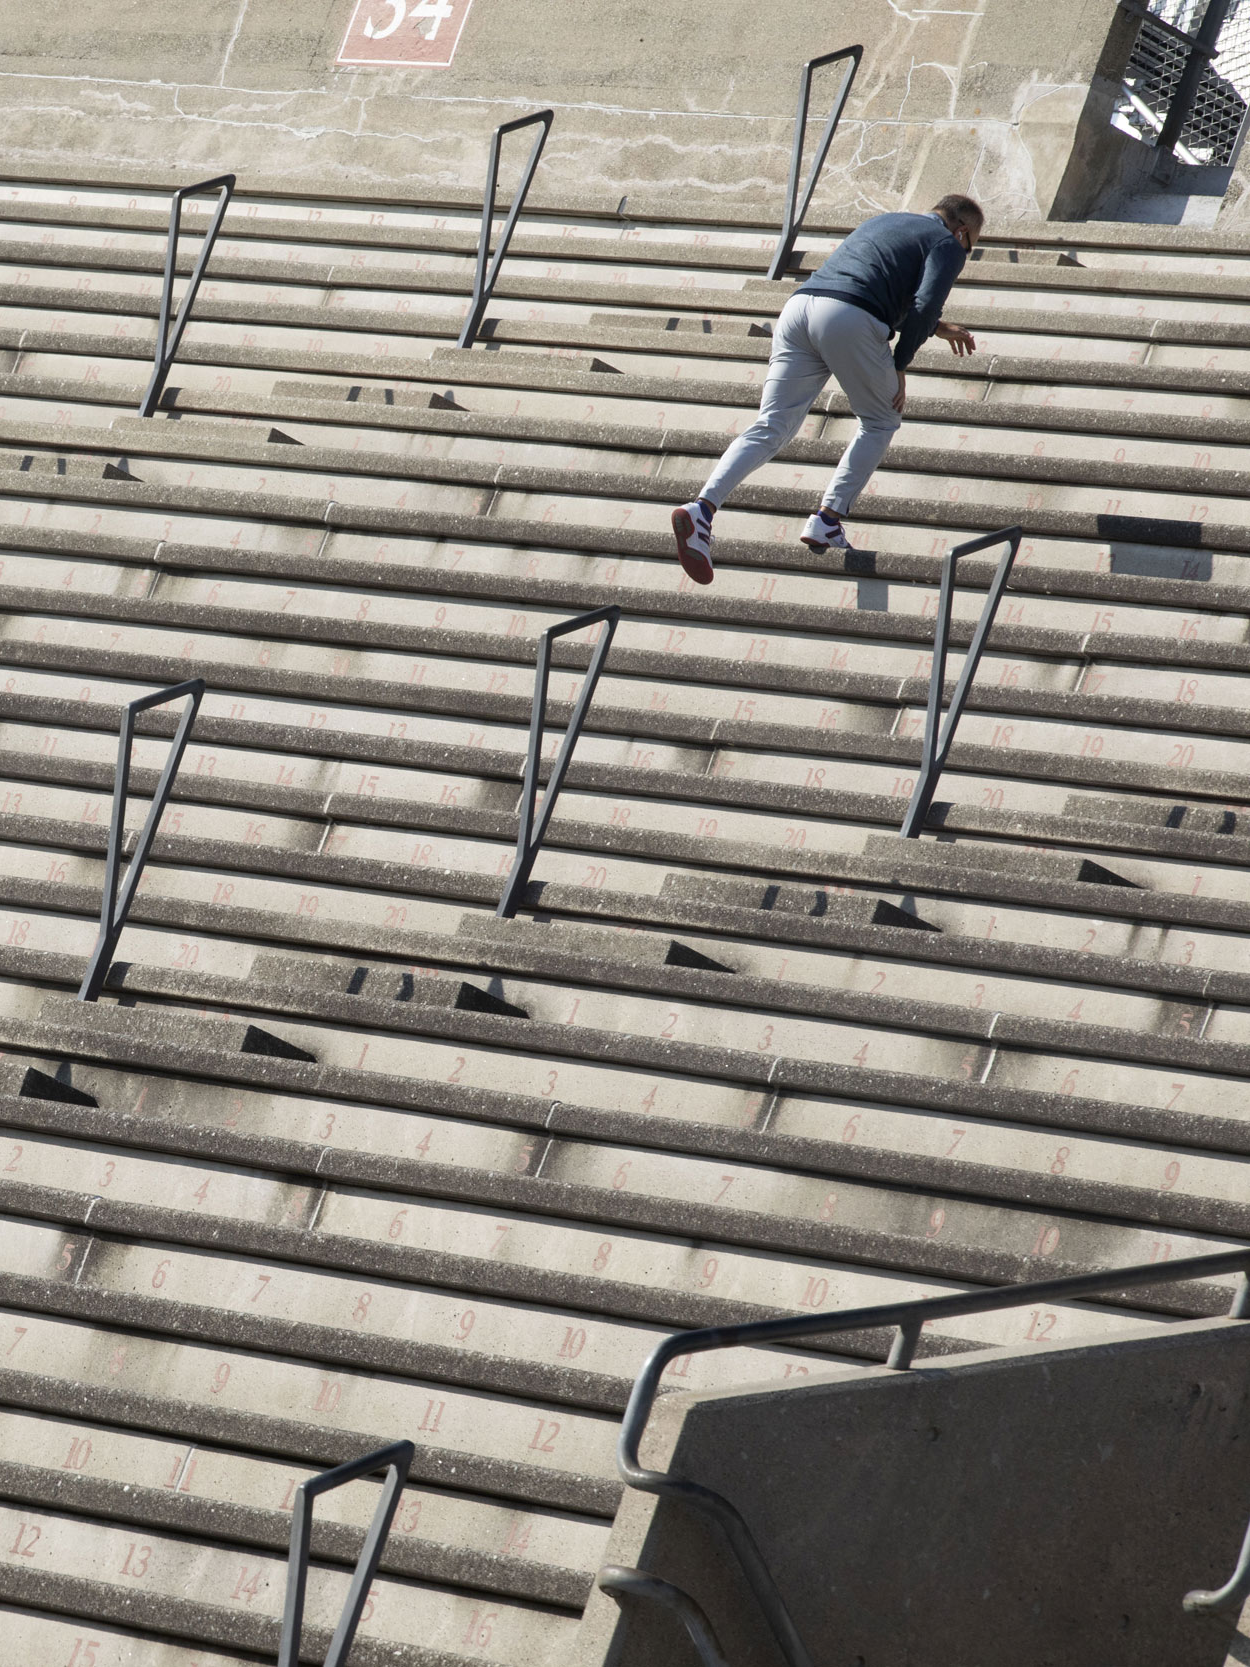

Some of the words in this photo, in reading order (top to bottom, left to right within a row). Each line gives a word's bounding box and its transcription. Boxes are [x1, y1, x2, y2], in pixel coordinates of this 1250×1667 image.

[201, 287, 217, 299] 15
[792, 472, 803, 486] 7
[621, 510, 632, 528] 7
[1104, 499, 1121, 513] 11
[1187, 504, 1209, 521] 12
[283, 590, 297, 609] 7
[757, 578, 777, 601] 11
[839, 587, 856, 609] 12
[505, 615, 527, 638] 10
[1091, 611, 1114, 633] 15
[663, 629, 686, 653] 12
[745, 638, 768, 662] 13
[827, 648, 849, 672] 14
[409, 664, 427, 683] 11
[486, 672, 509, 695] 12
[734, 699, 756, 720] 15
[991, 725, 1014, 747] 18
[1166, 744, 1195, 768] 20
[357, 774, 380, 796] 15
[805, 768, 826, 788] 18
[891, 778, 915, 797] 19
[2, 791, 22, 813] 13
[439, 785, 461, 806] 16
[80, 802, 100, 824] 14
[159, 811, 185, 834] 15
[609, 807, 630, 827] 18
[47, 860, 69, 882] 16
[1191, 875, 1203, 896] 1
[296, 893, 319, 917] 19
[6, 920, 31, 945] 18
[985, 915, 997, 939] 1
[869, 971, 887, 995] 2
[566, 998, 581, 1025] 1
[1067, 1000, 1084, 1022] 4
[661, 1012, 678, 1039] 2
[352, 1043, 370, 1070] 1
[853, 1043, 869, 1067] 4
[447, 1056, 466, 1084] 2
[541, 1070, 559, 1097] 3
[1166, 1083, 1185, 1110] 7
[641, 1087, 657, 1113] 4
[318, 1113, 338, 1140] 3
[842, 1114, 862, 1143] 6
[416, 1131, 432, 1155] 4
[946, 1128, 966, 1156] 7
[4, 1145, 23, 1171] 2
[1050, 1146, 1070, 1175] 8
[98, 1161, 116, 1187] 3
[612, 1159, 632, 1191] 6
[1160, 1161, 1181, 1190] 9
[193, 1180, 210, 1205] 4
[714, 1174, 734, 1204] 7
[925, 1208, 945, 1239] 9
[1031, 1226, 1060, 1256] 10
[592, 1242, 612, 1272] 8
[152, 1259, 171, 1289] 6
[697, 1258, 718, 1288] 9
[250, 1274, 271, 1302] 7
[798, 1276, 829, 1307] 10
[352, 1292, 373, 1321] 8
[455, 1308, 476, 1341] 9
[1025, 1311, 1057, 1342] 12
[6, 1326, 28, 1356] 7
[558, 1326, 586, 1359] 10
[210, 1362, 231, 1394] 9
[313, 1379, 342, 1411] 10
[418, 1399, 445, 1432] 11
[528, 1418, 560, 1453] 12
[62, 1437, 92, 1470] 10
[166, 1456, 197, 1492] 11
[10, 1522, 41, 1558] 12
[120, 1544, 153, 1578] 13
[231, 1566, 261, 1600] 14
[462, 1610, 498, 1648] 16
[68, 1637, 100, 1667] 15
